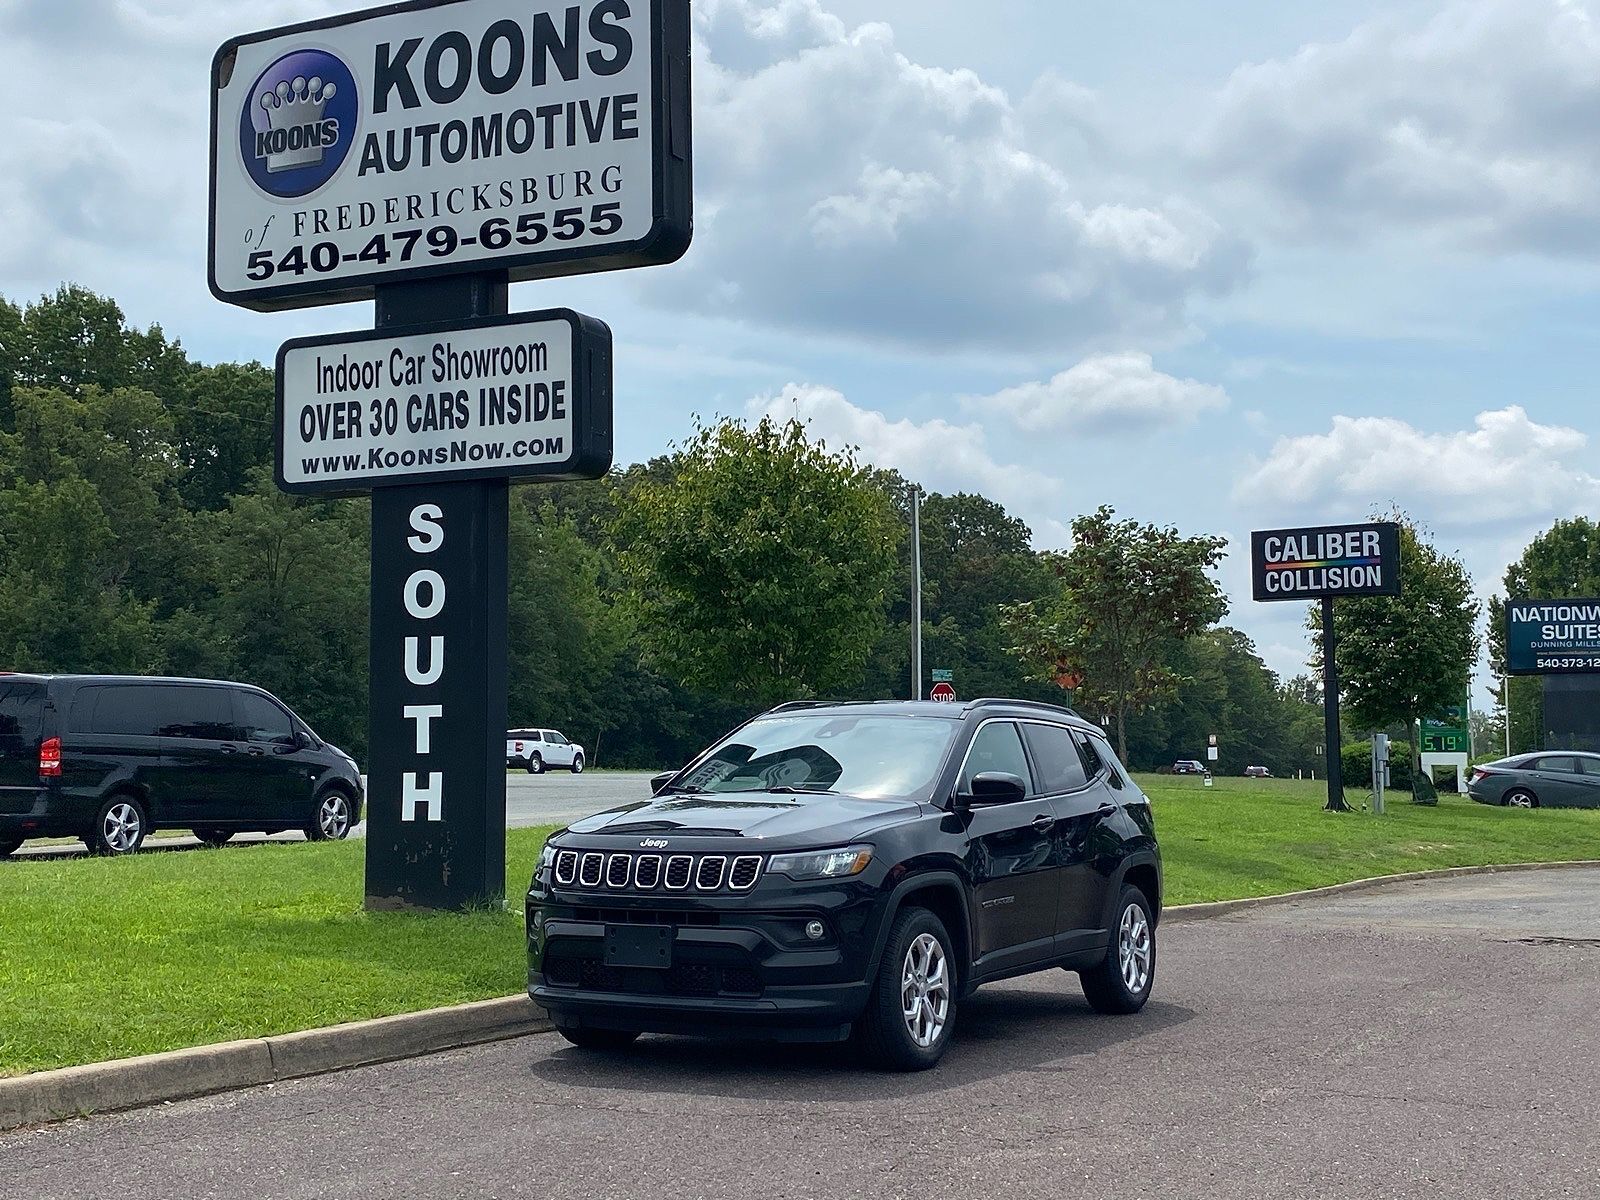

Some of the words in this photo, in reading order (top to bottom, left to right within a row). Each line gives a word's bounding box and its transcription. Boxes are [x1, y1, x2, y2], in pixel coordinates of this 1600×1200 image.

[373, 0, 633, 114] KOONS
[256, 119, 338, 158] KOONS
[357, 93, 639, 177] AUTOMOTIVE
[244, 215, 275, 249] of
[293, 165, 623, 237] FREDERICKSBURG
[245, 201, 623, 281] 540-479-6555
[316, 354, 383, 394] Indoor
[389, 347, 425, 387] Car
[431, 341, 547, 384] Showroom
[300, 400, 362, 443] OVER
[370, 398, 398, 437] 30
[406, 389, 469, 434] CARS
[479, 380, 566, 426] INSIDE
[1264, 530, 1381, 563] CALIBER
[1265, 565, 1382, 593] COLLISION
[1541, 624, 1600, 640] SUITE
[401, 503, 446, 822] SOUTH
[932, 693, 954, 702] STOP
[639, 837, 669, 849] Jeep
